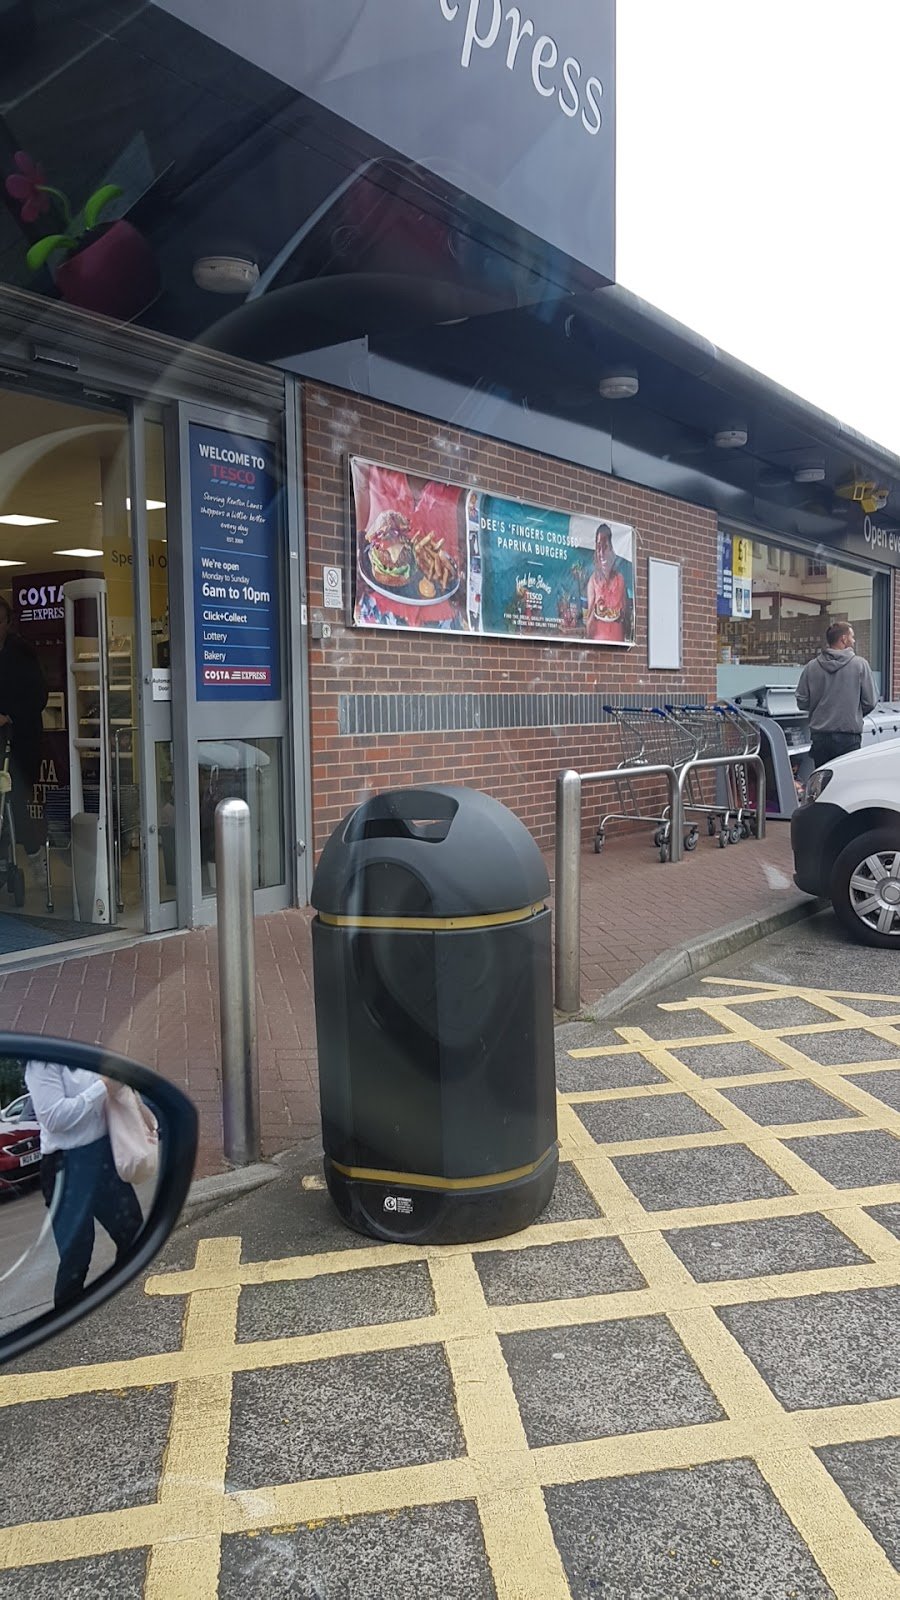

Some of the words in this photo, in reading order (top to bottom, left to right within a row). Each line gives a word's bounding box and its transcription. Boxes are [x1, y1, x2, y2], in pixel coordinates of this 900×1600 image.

[199, 443, 250, 467] WELCOME
[251, 456, 265, 470] TO
[210, 464, 256, 485] TESCO
[203, 491, 225, 508] Serving
[200, 506, 225, 517] shoppers
[231, 510, 247, 520] little
[250, 512, 266, 523] better
[220, 522, 237, 534] every
[238, 524, 249, 536] day
[480, 517, 505, 533] DEE'S
[864, 515, 887, 550] Open
[497, 536, 532, 554] PAPRIKA
[534, 544, 568, 561] BURGERS
[201, 557, 222, 569] We're
[222, 562, 240, 572] open
[202, 571, 224, 583] Monday
[224, 574, 230, 582] to
[230, 574, 250, 585] Sunday
[202, 582, 226, 599] 6am
[228, 586, 240, 600] to
[242, 586, 270, 604] 10pm
[33, 606, 65, 621] EXPRES
[202, 610, 248, 623] Click+Collect
[203, 631, 228, 644] Lottery
[204, 650, 226, 663] Bakery
[204, 670, 230, 680] COSTA
[241, 671, 267, 681] EXPRESS
